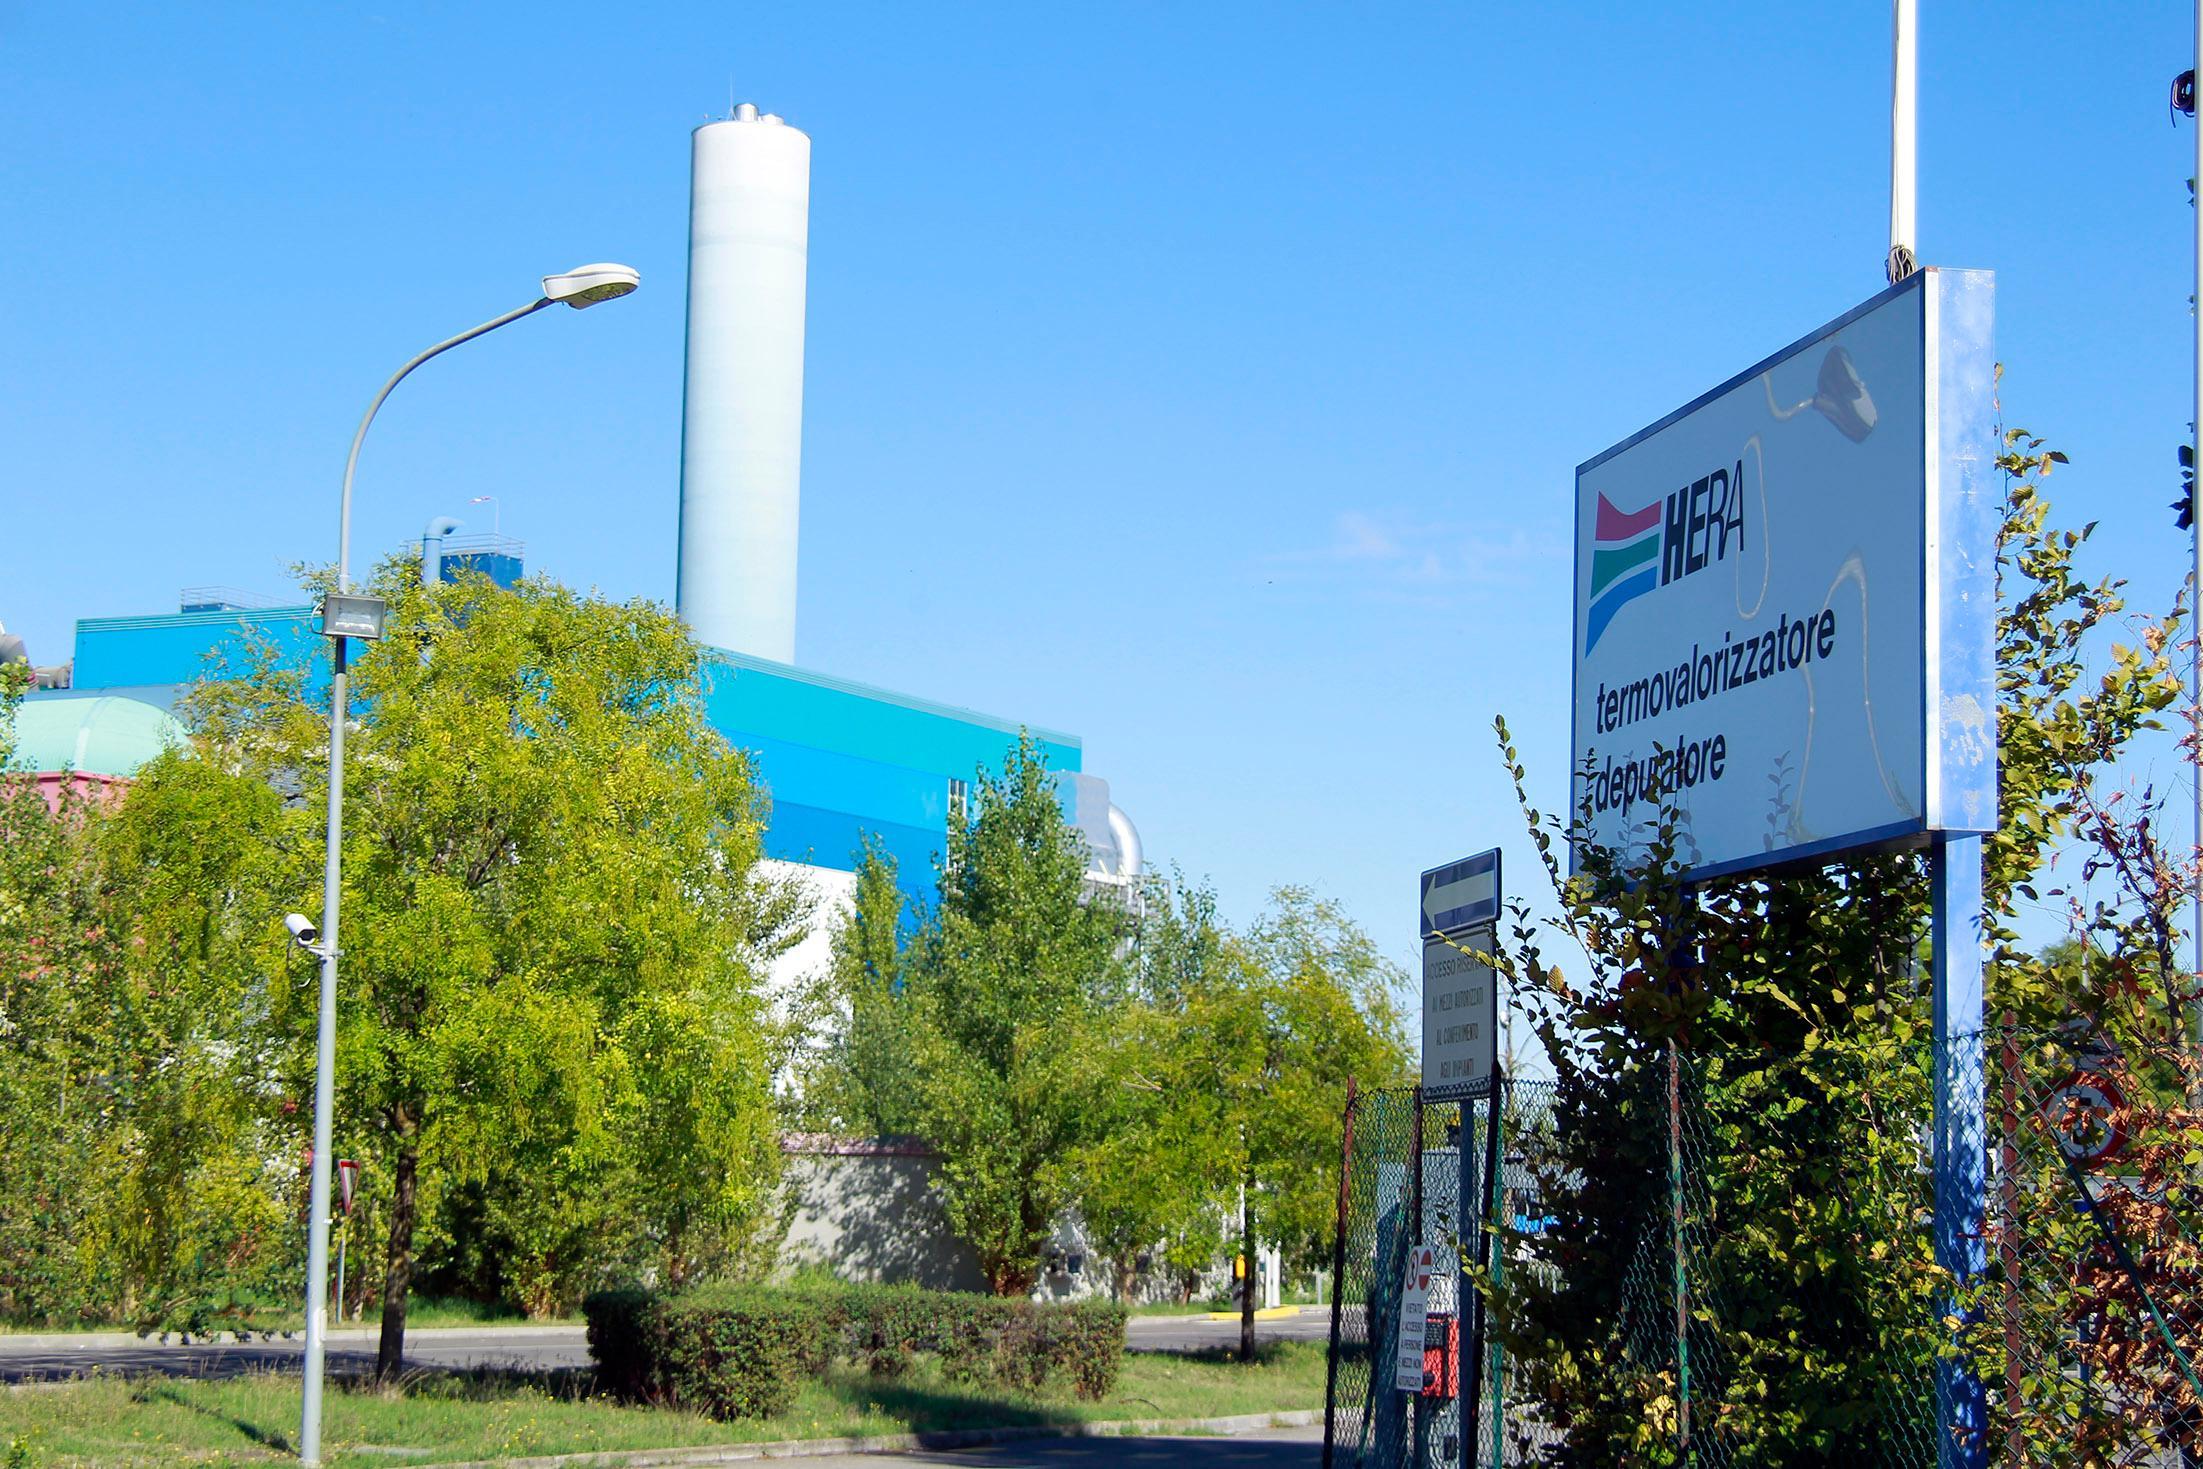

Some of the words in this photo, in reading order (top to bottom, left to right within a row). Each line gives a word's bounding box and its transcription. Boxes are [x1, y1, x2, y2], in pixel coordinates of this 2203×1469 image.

[1661, 459, 1744, 587] HERA
[1597, 609, 1835, 734] termovalorizzatore
[1427, 958, 1456, 979] ACCESSO
